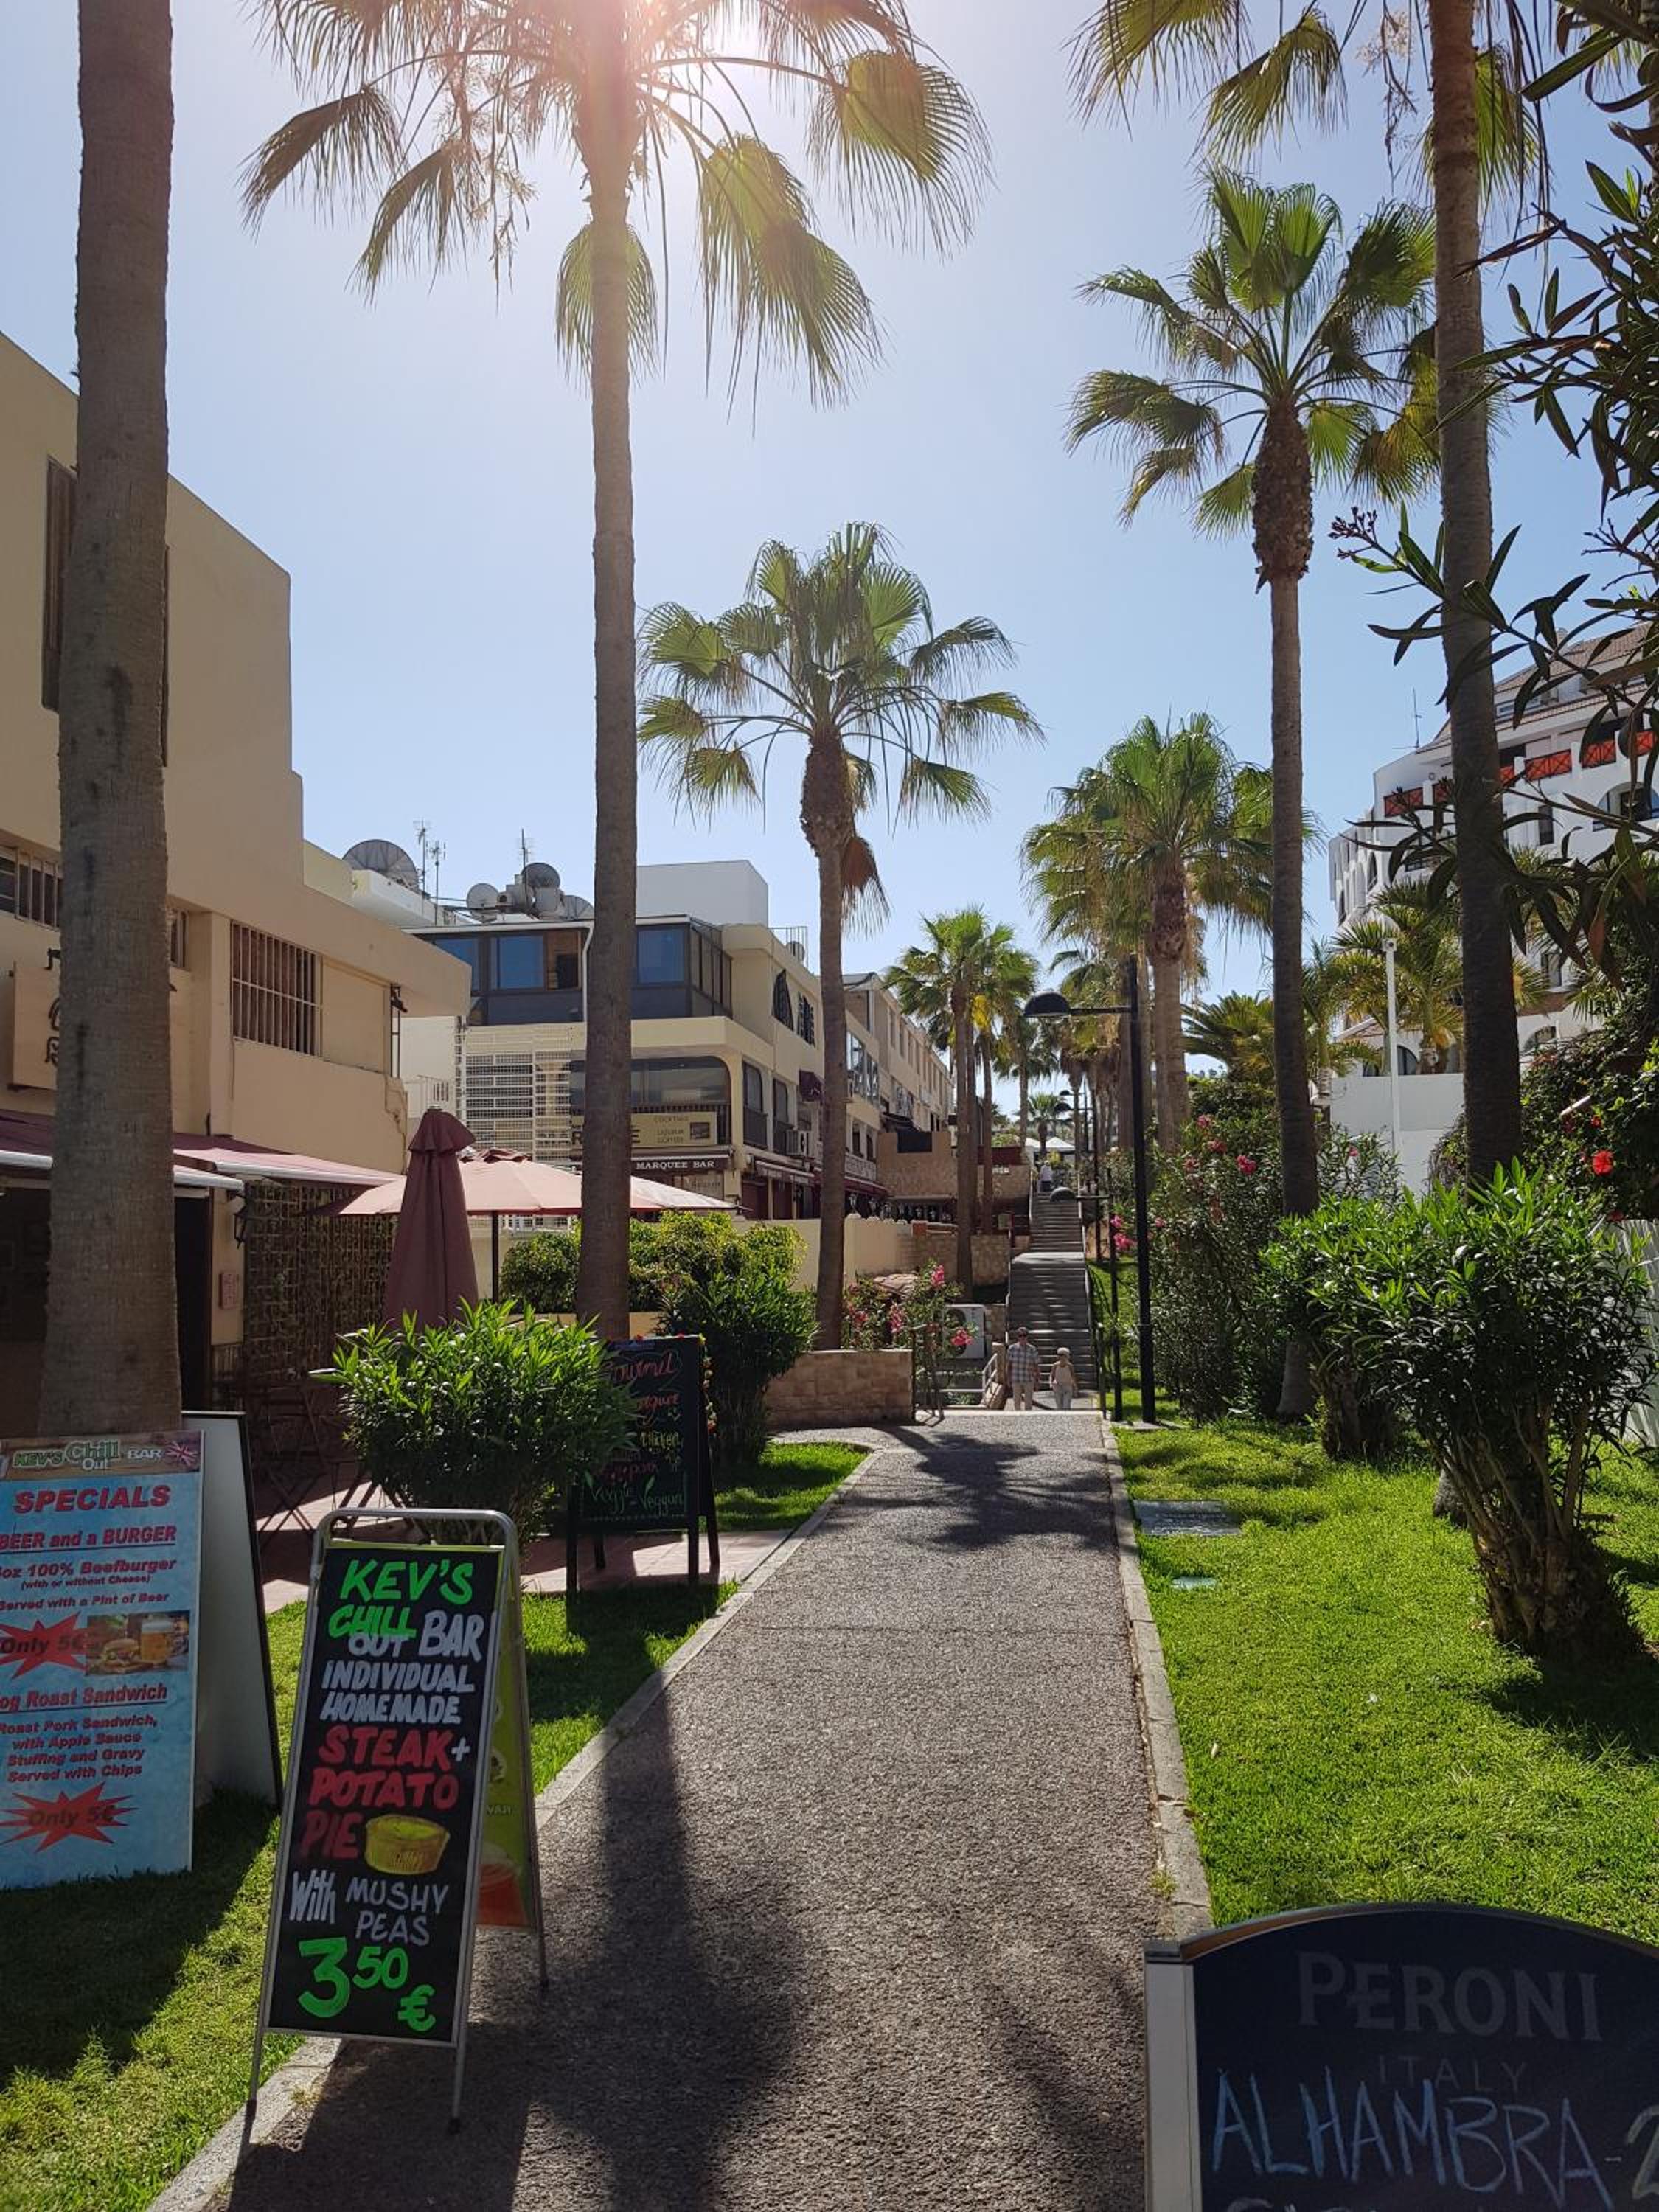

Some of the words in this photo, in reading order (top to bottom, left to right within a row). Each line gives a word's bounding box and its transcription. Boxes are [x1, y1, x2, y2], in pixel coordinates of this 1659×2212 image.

[636, 1161, 687, 1170] MARQUEE
[692, 1160, 714, 1168] BAR
[13, 1450, 65, 1469] KEV'S
[65, 1439, 121, 1463] Chill
[128, 1448, 162, 1460] BAR
[82, 1458, 110, 1471] Out
[13, 1484, 171, 1514] SPECIALS
[0, 1531, 46, 1549] BEER
[49, 1529, 83, 1548] and
[86, 1532, 97, 1546] a
[102, 1524, 178, 1545] BURGER
[21, 1578, 49, 1590] (with
[51, 1579, 62, 1588] or
[66, 1575, 105, 1587] without
[27, 1562, 74, 1577] 100%
[80, 1559, 177, 1575] Beefburger
[339, 1559, 474, 1605] KEV'S
[47, 1596, 75, 1608] with
[80, 1598, 88, 1607] a
[92, 1594, 119, 1606] Pint
[122, 1592, 135, 1604] of
[138, 1592, 170, 1603] Beer
[1, 1636, 49, 1655] Only
[327, 1604, 417, 1639] CHILL
[418, 1610, 484, 1663] BAR
[348, 1631, 411, 1658] OUT
[321, 1660, 476, 1693] INDIVIDUAL
[0, 1694, 21, 1711] og
[27, 1688, 77, 1708] Roast
[82, 1682, 168, 1704] Sandwich
[319, 1691, 462, 1725] HOMEMADE
[44, 1719, 77, 1732] Pork
[82, 1713, 159, 1729] Sandwich,
[12, 1737, 44, 1750] with
[48, 1734, 91, 1750] Apple
[94, 1732, 142, 1745] Sauce
[7, 1753, 66, 1767] Stuffing
[69, 1750, 98, 1763] and
[102, 1747, 145, 1760] Gravy
[7, 1770, 60, 1783] Served
[64, 1767, 97, 1778] with
[101, 1764, 143, 1778] Chips
[307, 1767, 459, 1812] POTATO
[28, 1810, 80, 1829] Only
[301, 1809, 364, 1862] PIE
[345, 1877, 449, 1915] MUSHY
[354, 1910, 431, 1947] PEAS
[1296, 1950, 1603, 2042] PERONI
[1379, 2054, 1526, 2093] ITALY
[1212, 2065, 1614, 2212] ALHAMBRA
